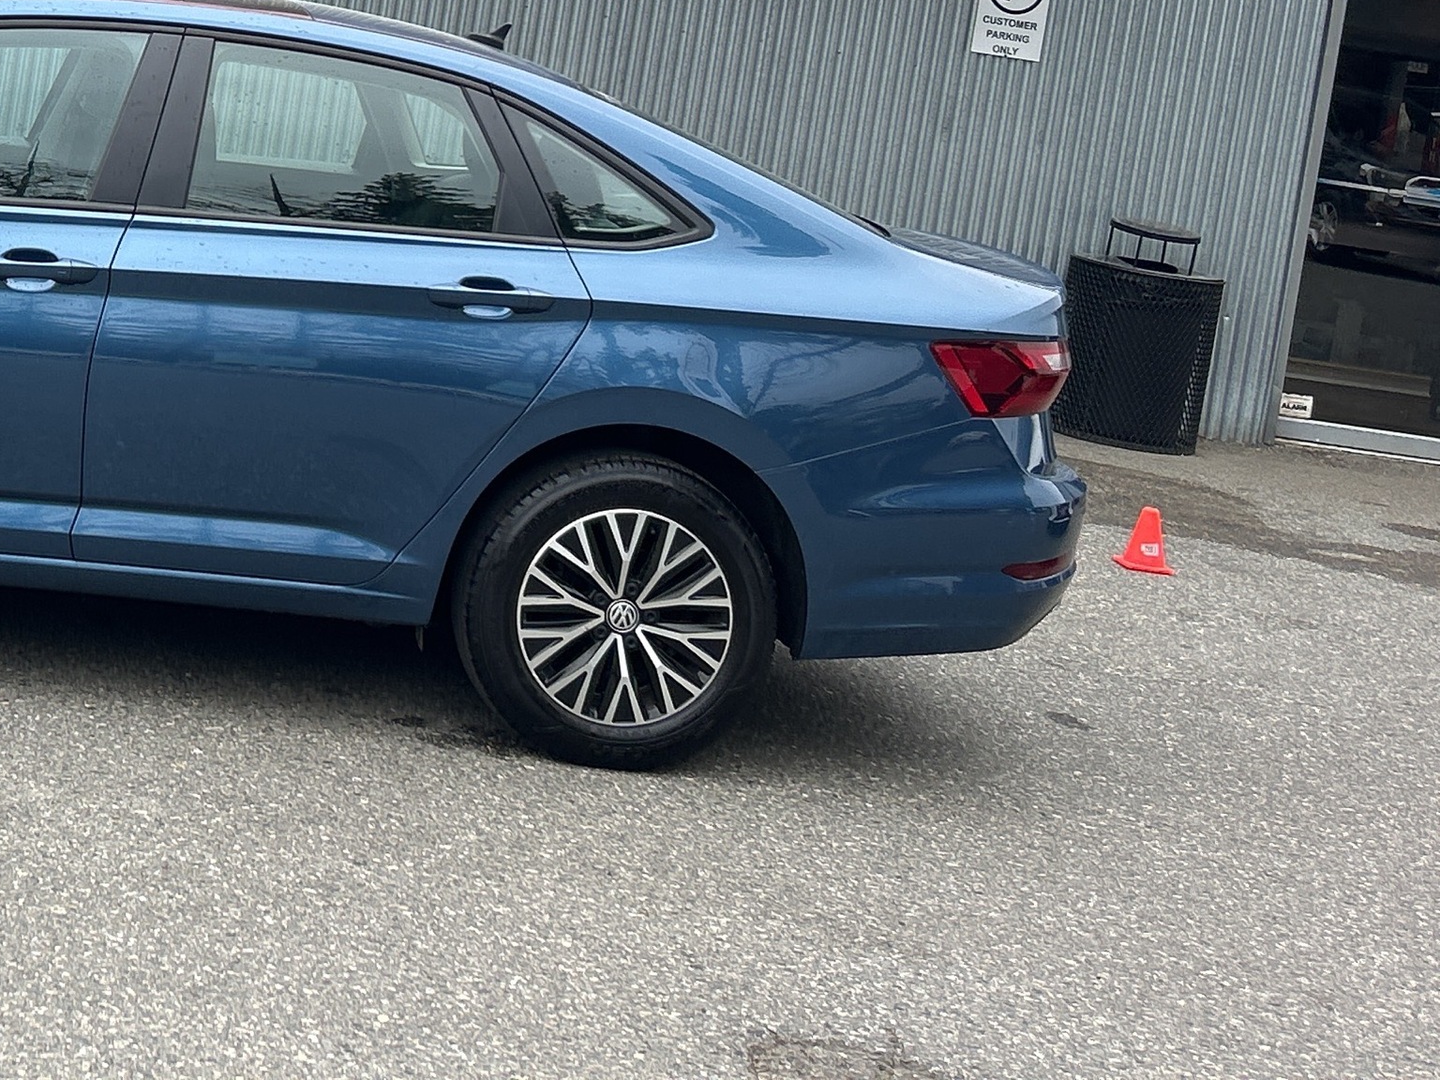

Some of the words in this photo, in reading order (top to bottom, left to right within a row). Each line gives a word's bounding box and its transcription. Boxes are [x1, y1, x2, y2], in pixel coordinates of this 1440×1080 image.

[982, 15, 1038, 31] CUSTOMER
[986, 29, 1030, 43] PARKING
[992, 44, 1020, 56] ONLY
